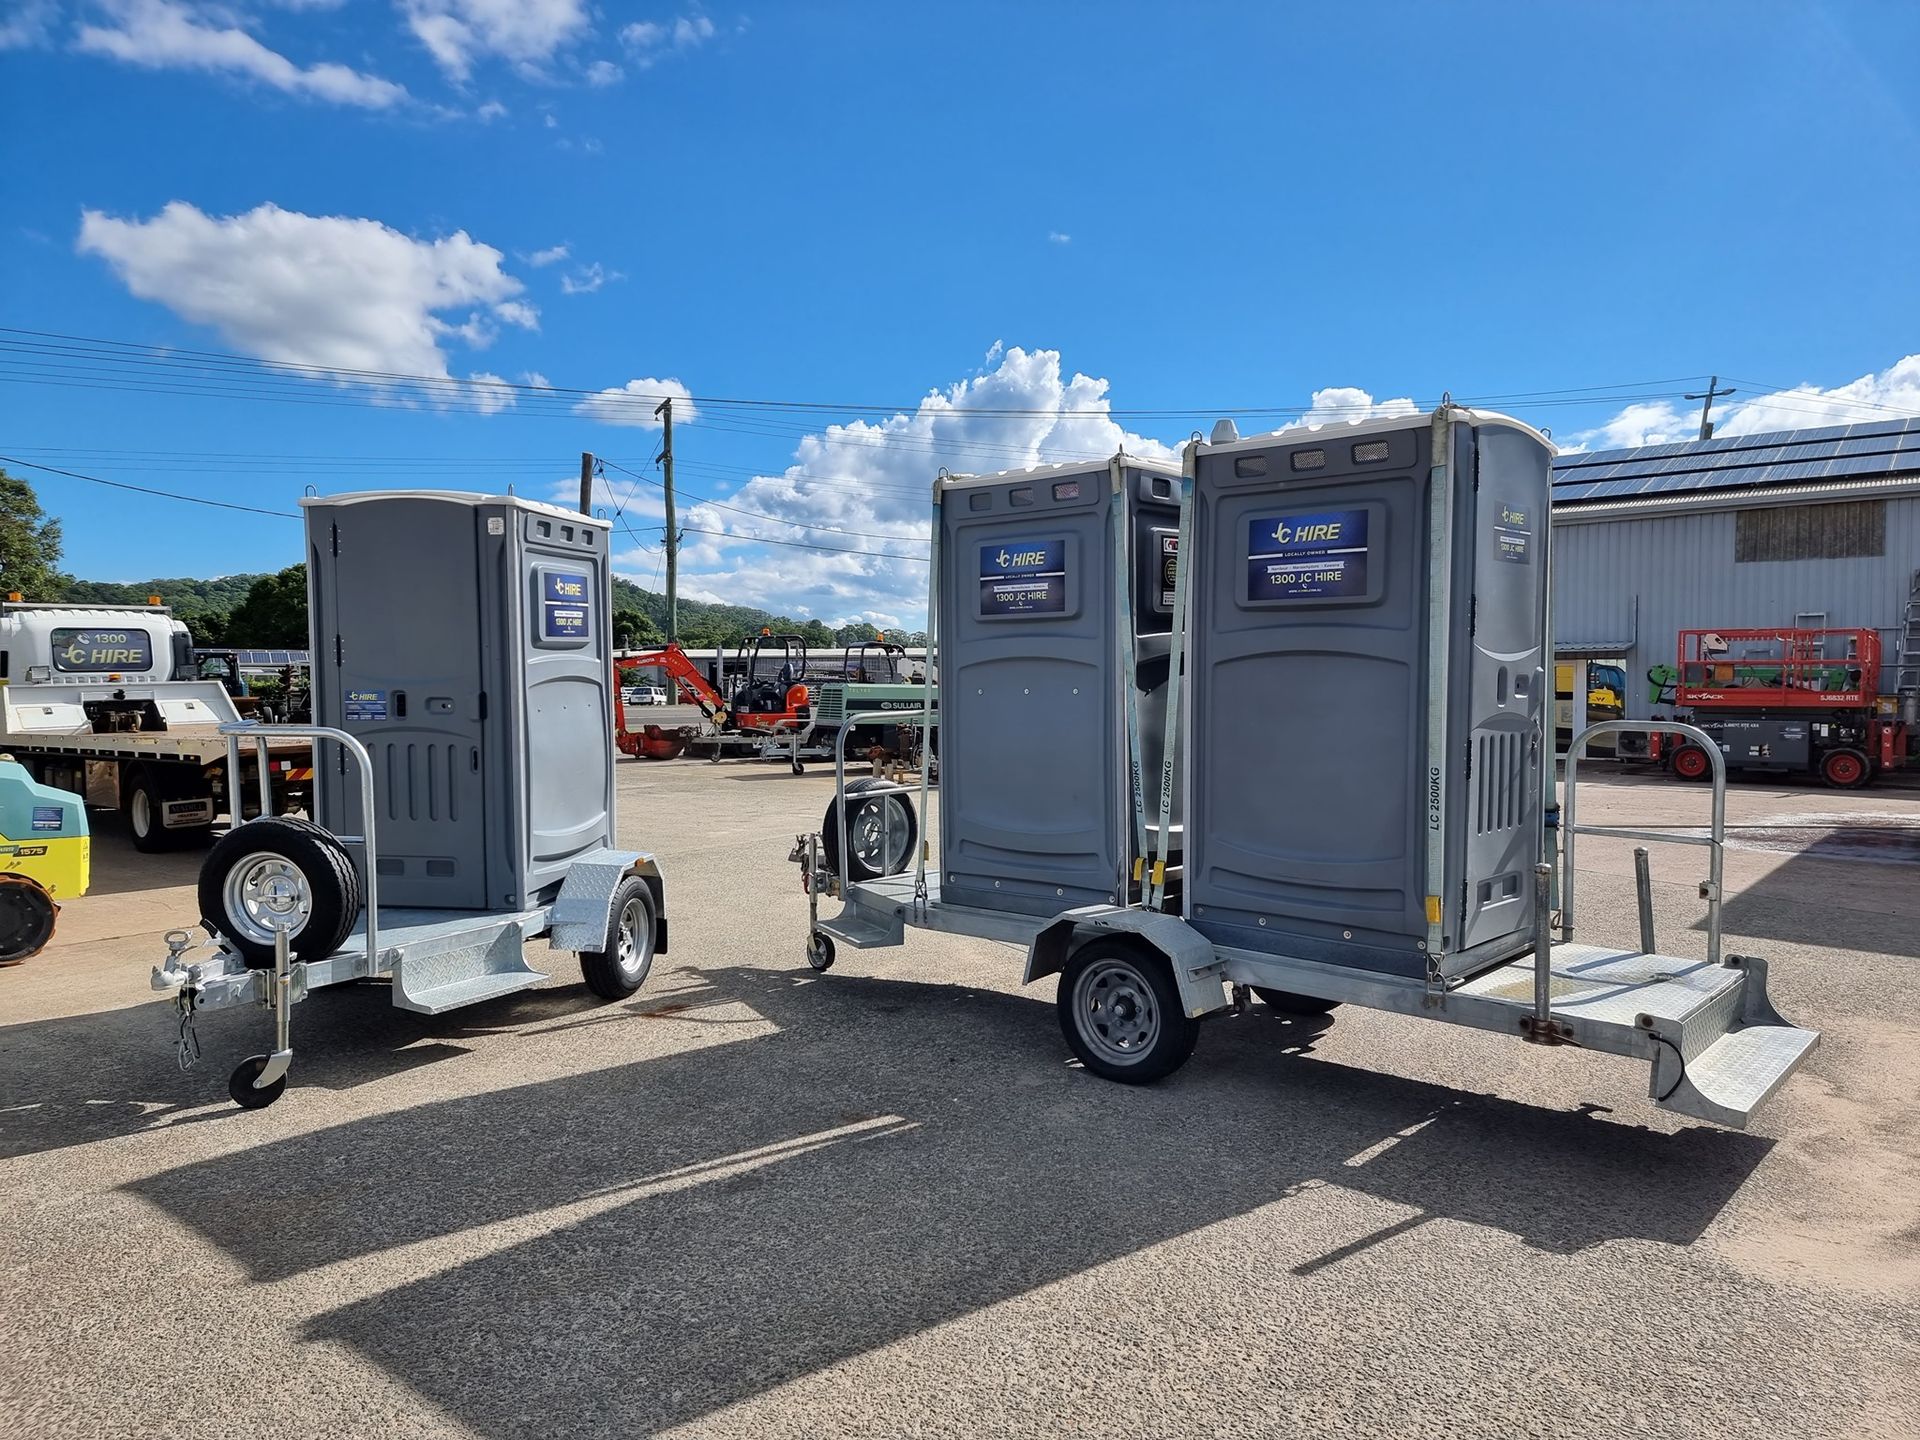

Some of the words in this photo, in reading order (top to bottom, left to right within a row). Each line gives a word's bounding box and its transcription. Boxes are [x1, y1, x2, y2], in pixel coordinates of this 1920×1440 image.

[1502, 505, 1509, 522] JC
[1509, 511, 1524, 525] HIRE
[1271, 522, 1291, 543] JC
[1294, 523, 1341, 543] HIRE
[995, 549, 1010, 568] JC
[1012, 551, 1045, 567] HIRE
[1270, 573, 1296, 584] 1300
[1298, 572, 1312, 583] JC
[1315, 571, 1342, 582] HIRE
[554, 577, 565, 595] JC
[564, 583, 582, 596] HIRE
[996, 593, 1014, 602] 1300
[1016, 592, 1026, 601] JC
[1027, 590, 1047, 600] HIRE
[94, 634, 127, 644] 1300
[61, 643, 87, 664] JC
[90, 649, 143, 664] HIRE
[359, 693, 379, 701] HIRE
[1687, 692, 1724, 700] SKYJACK
[1820, 694, 1845, 702] SJ6832
[1133, 761, 1142, 798] 2500KG
[1162, 760, 1172, 799] 2500KG
[1430, 767, 1440, 811] 2500KG
[1137, 800, 1143, 814] LC
[1162, 800, 1170, 814] LC
[1430, 814, 1440, 831] LC
[20, 847, 44, 855] 1575
